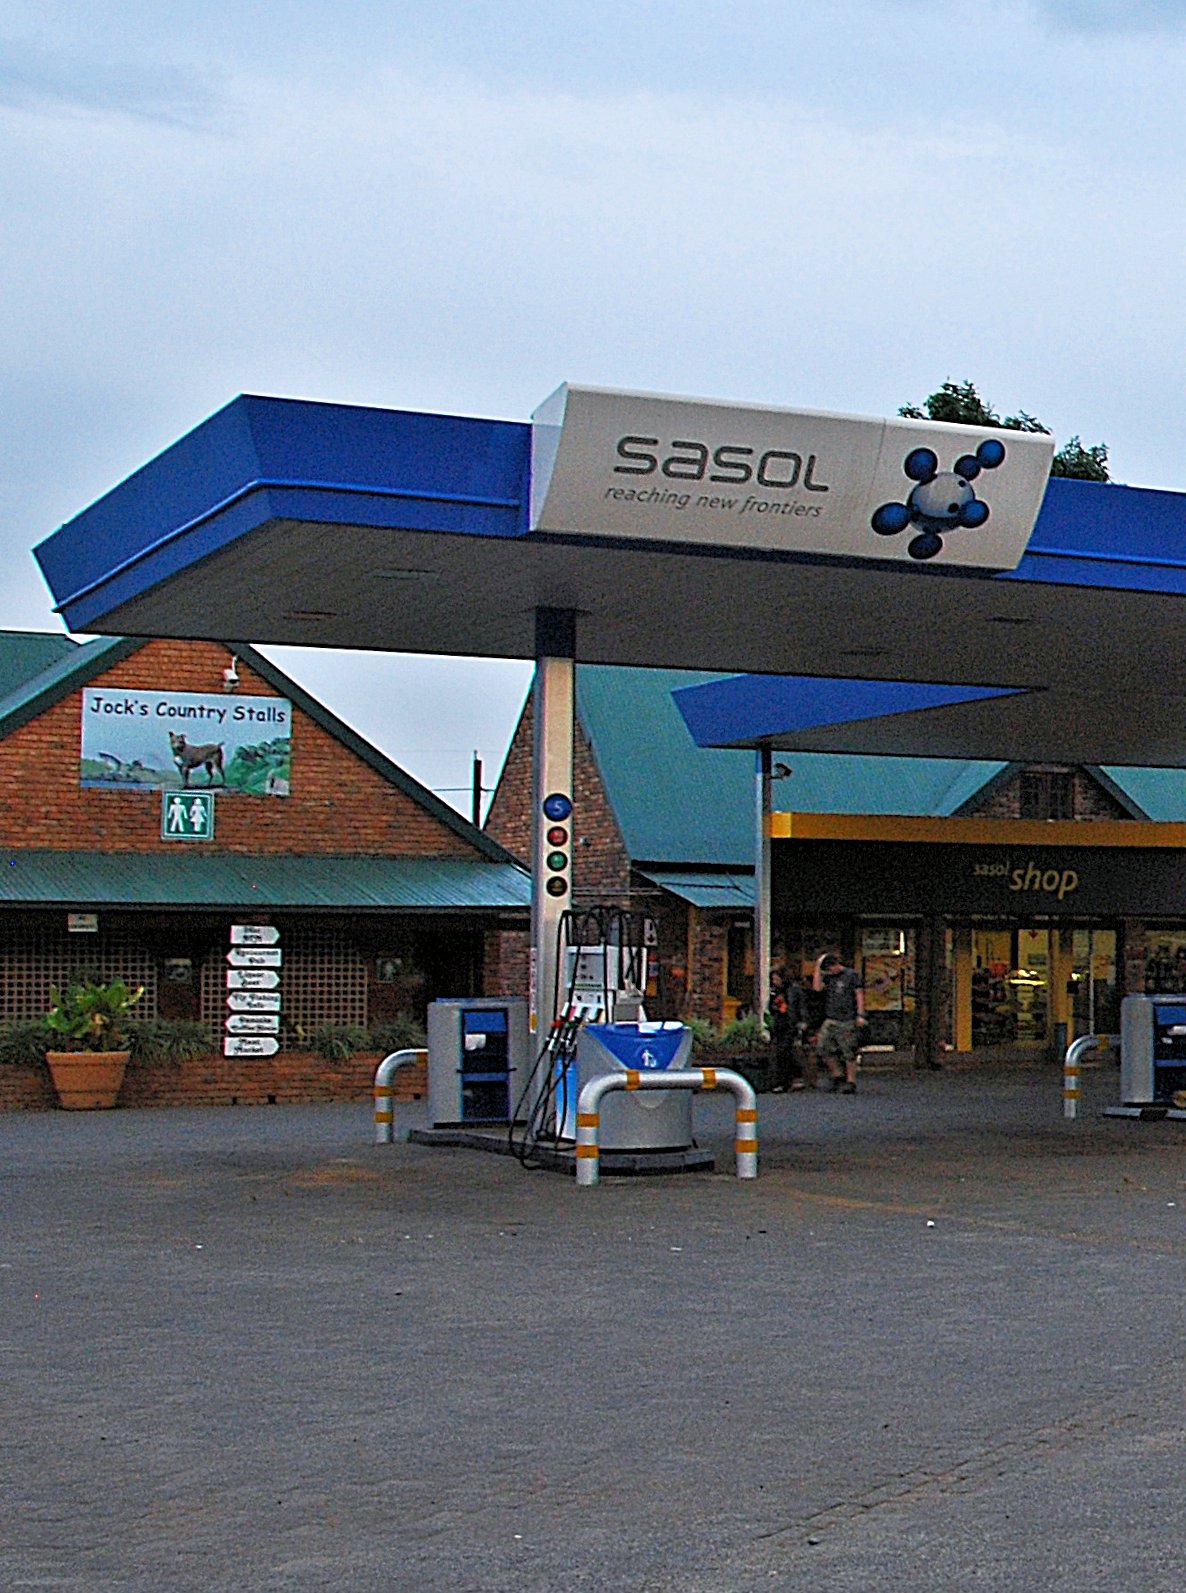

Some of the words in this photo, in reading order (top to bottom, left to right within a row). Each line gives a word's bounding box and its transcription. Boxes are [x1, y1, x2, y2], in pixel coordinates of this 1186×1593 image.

[613, 435, 830, 492] sasol
[604, 485, 692, 510] reaching
[696, 495, 738, 511] new
[739, 496, 824, 518] frontiers
[90, 696, 149, 716] Jock's
[155, 702, 227, 724] Country
[232, 705, 286, 723] Stalls
[553, 800, 565, 815] 5
[1008, 861, 1079, 900] shop
